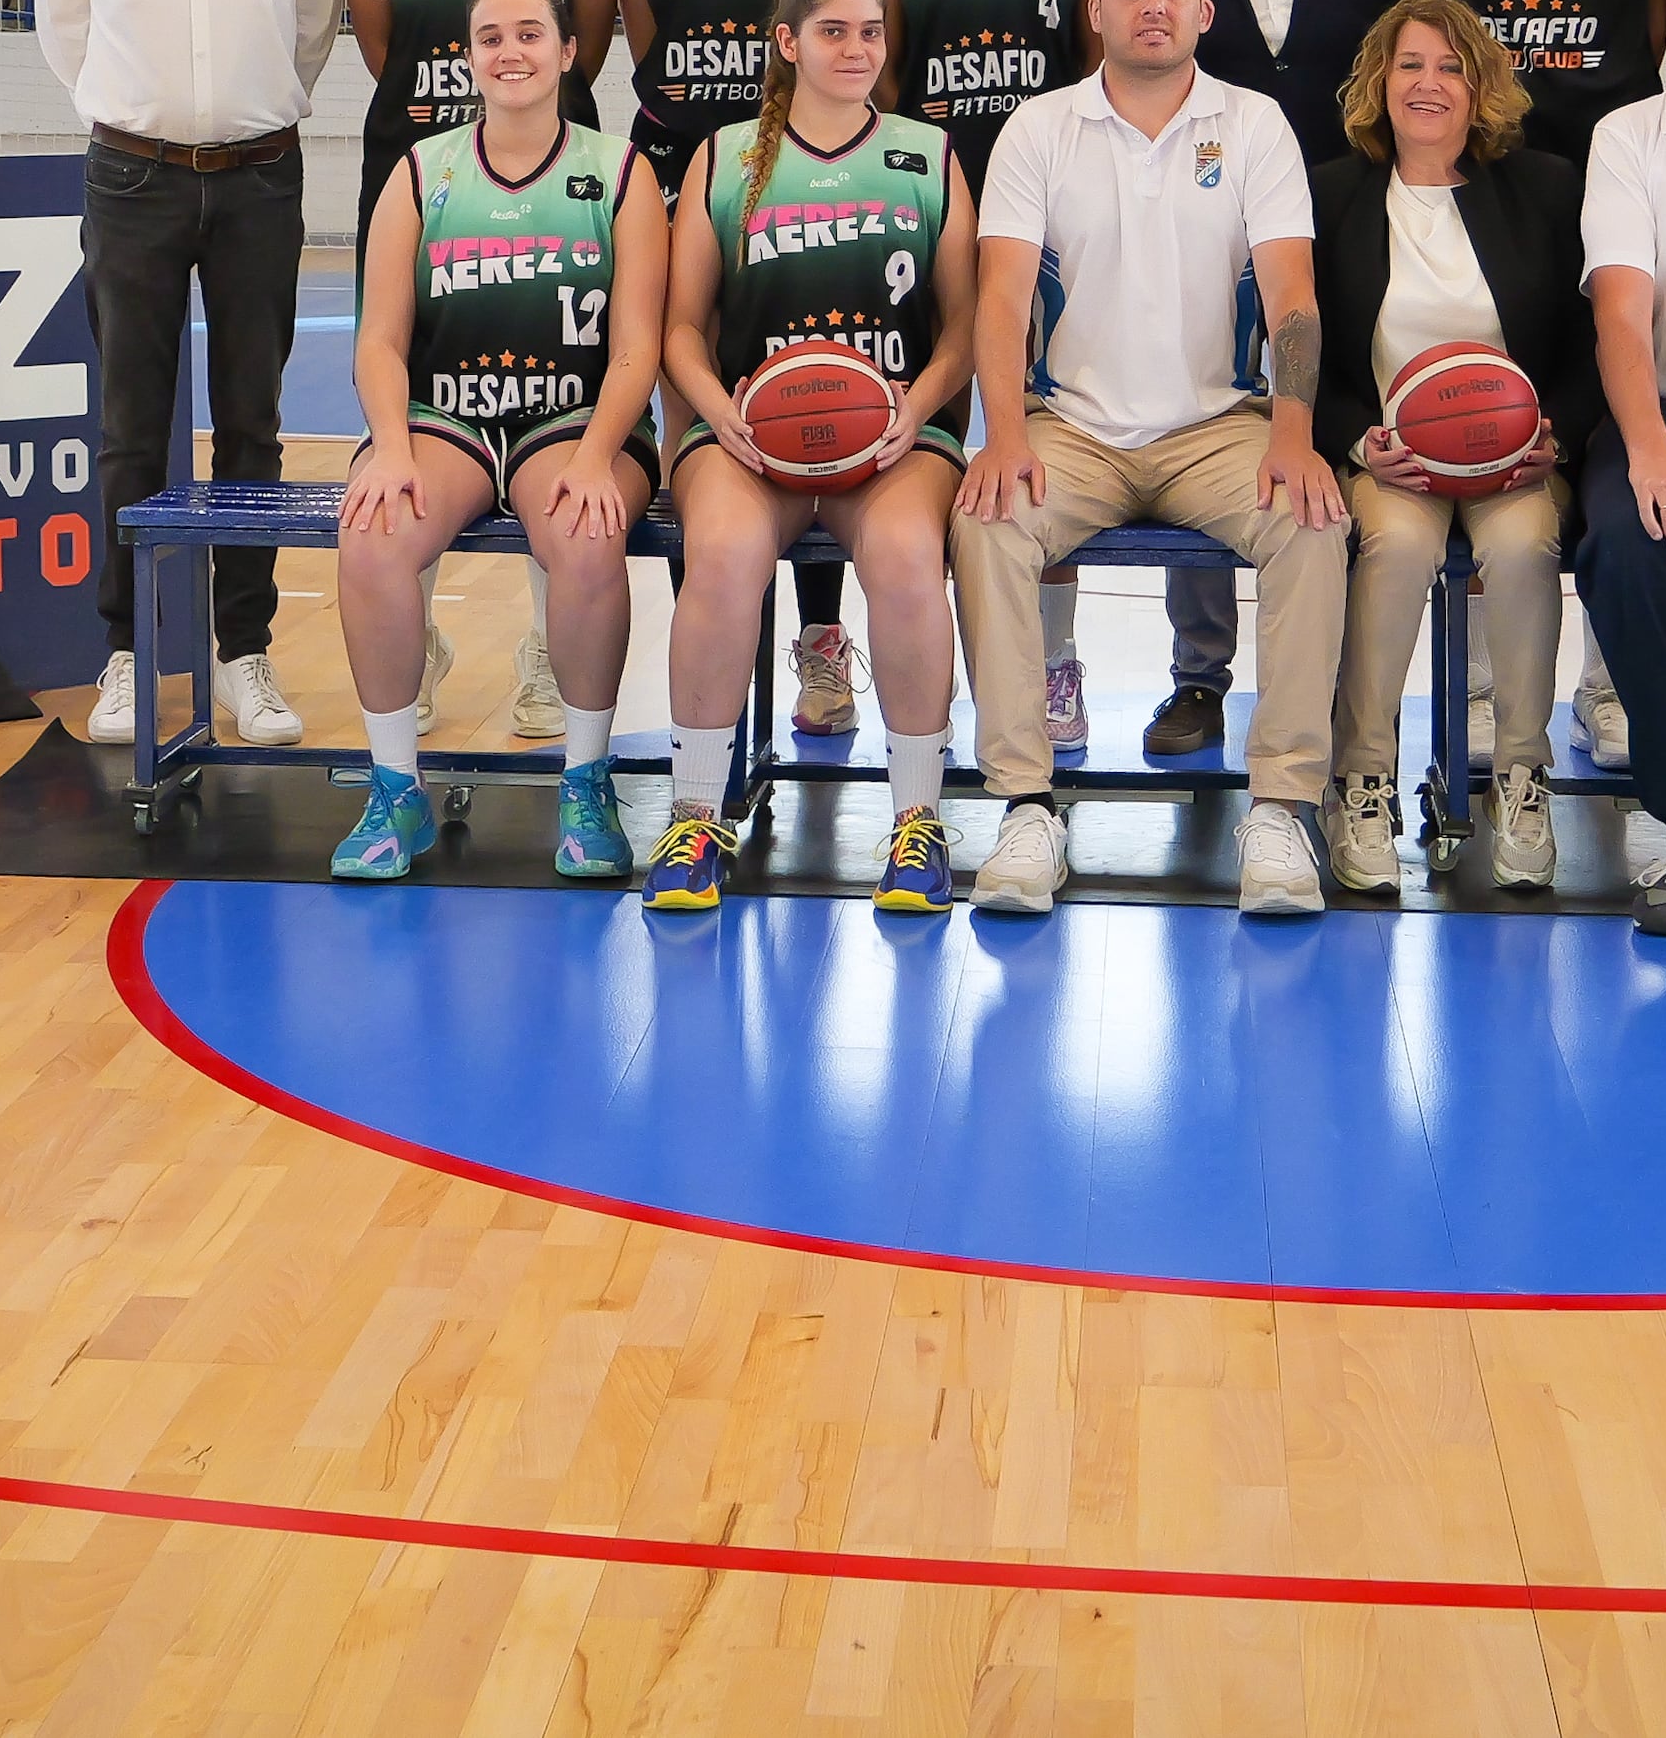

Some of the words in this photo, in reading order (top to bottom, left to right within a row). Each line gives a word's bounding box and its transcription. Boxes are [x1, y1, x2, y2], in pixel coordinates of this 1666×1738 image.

[665, 40, 770, 77] DESAFI
[927, 49, 1046, 95] DESAFIO
[745, 200, 886, 266] XEREZ
[427, 236, 564, 298] XEREZ
[884, 250, 916, 306] 9
[557, 285, 607, 346] 12
[433, 374, 583, 418] DESAFIO
